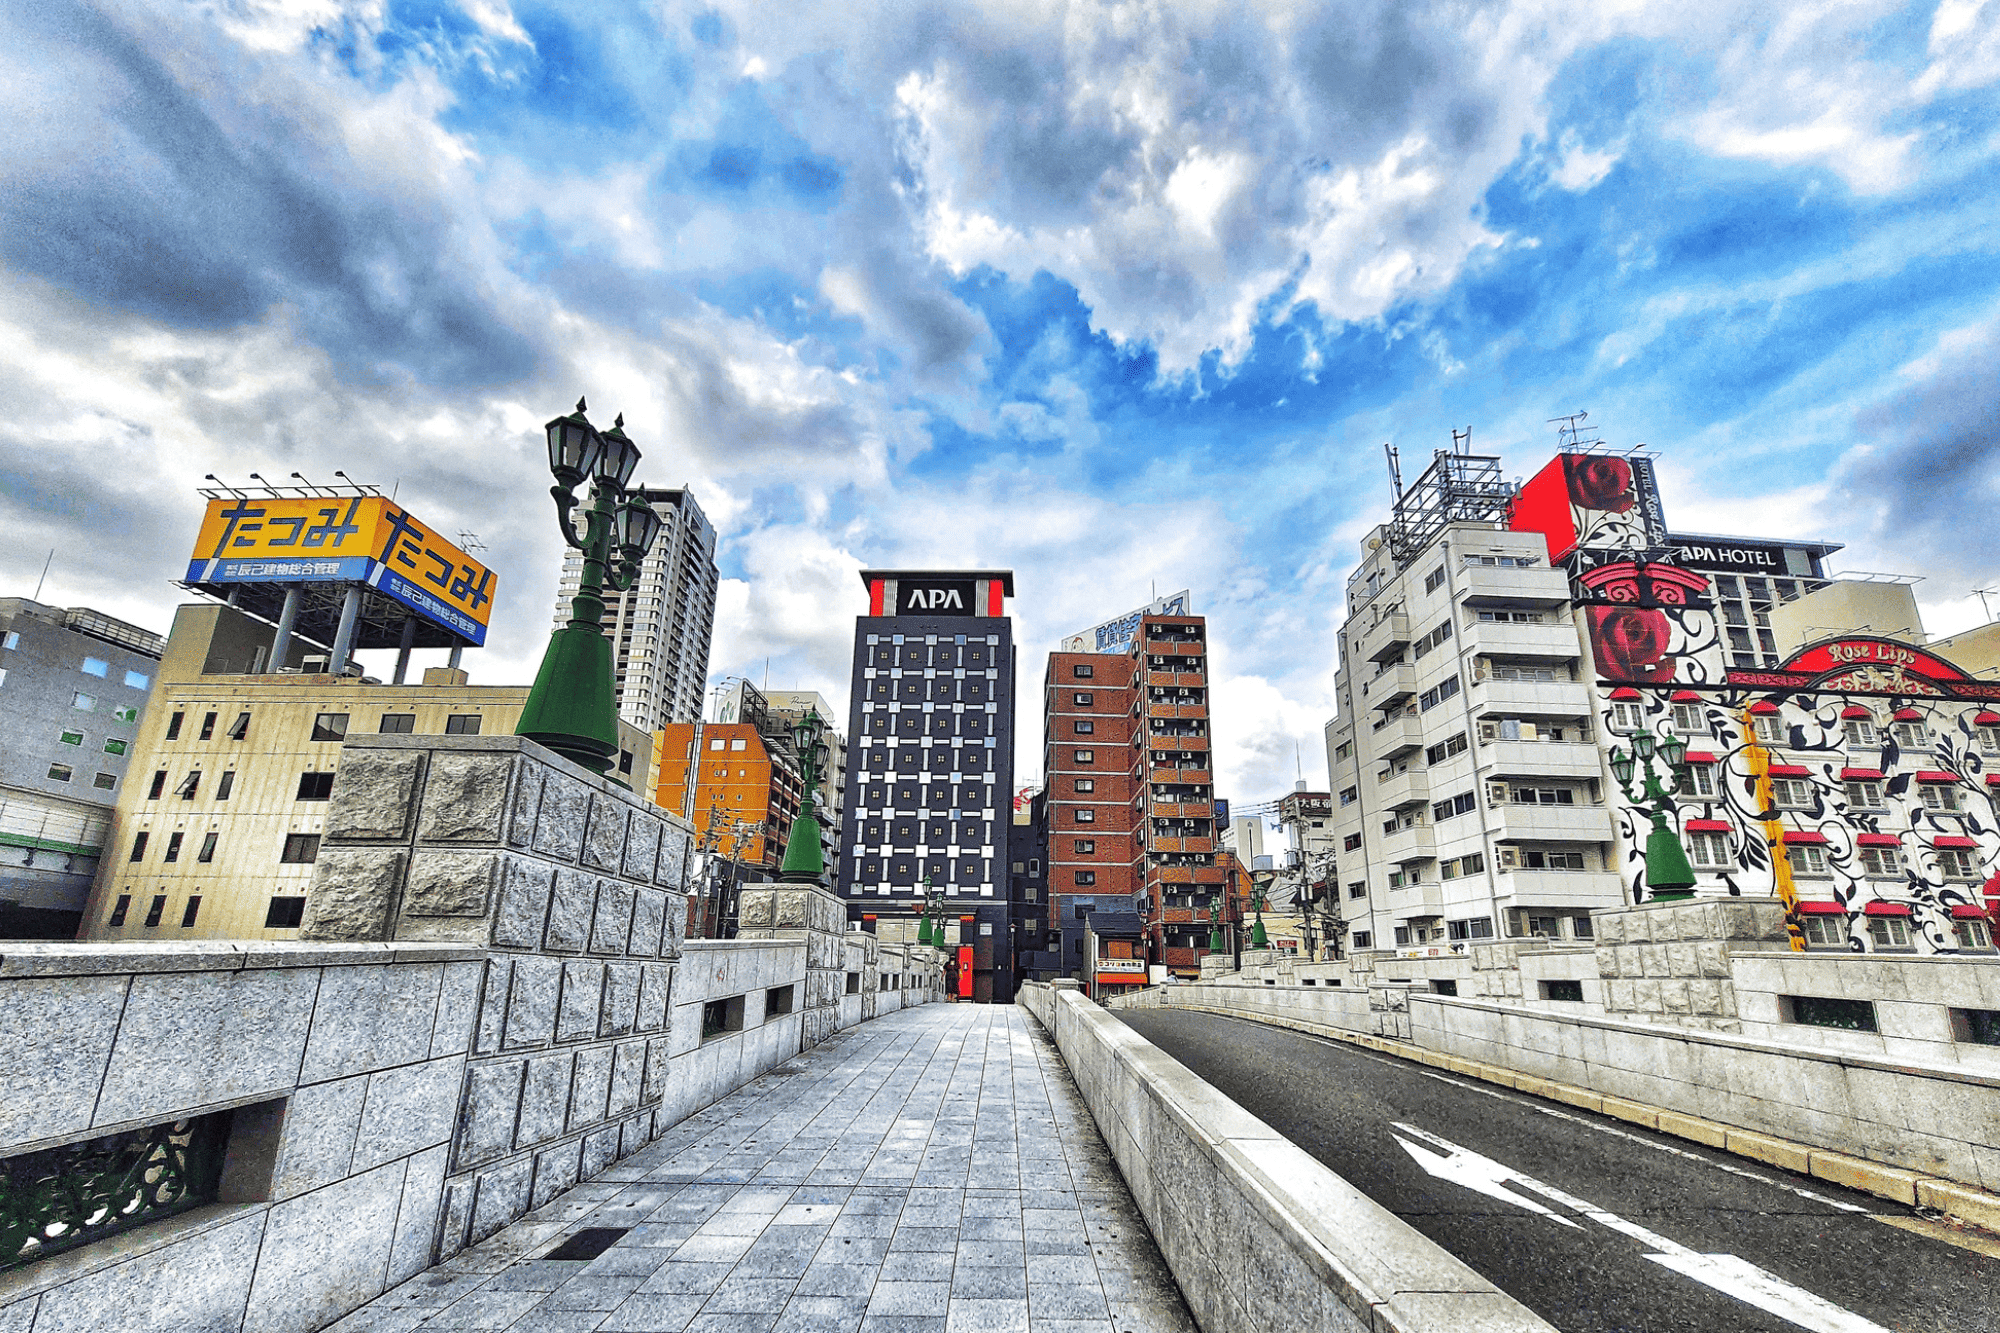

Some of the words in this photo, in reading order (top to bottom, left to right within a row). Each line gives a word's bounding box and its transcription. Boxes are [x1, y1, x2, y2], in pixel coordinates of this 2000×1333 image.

[1639, 459, 1653, 490] HOTEL
[1645, 492, 1660, 520] Rose
[213, 497, 361, 558] たつみ
[379, 509, 491, 609] たつみ
[1681, 546, 1717, 562] APA
[1718, 549, 1777, 566] HOTEL
[907, 589, 964, 609] APA
[1828, 643, 1870, 662] Rose
[1876, 645, 1916, 665] Lips
